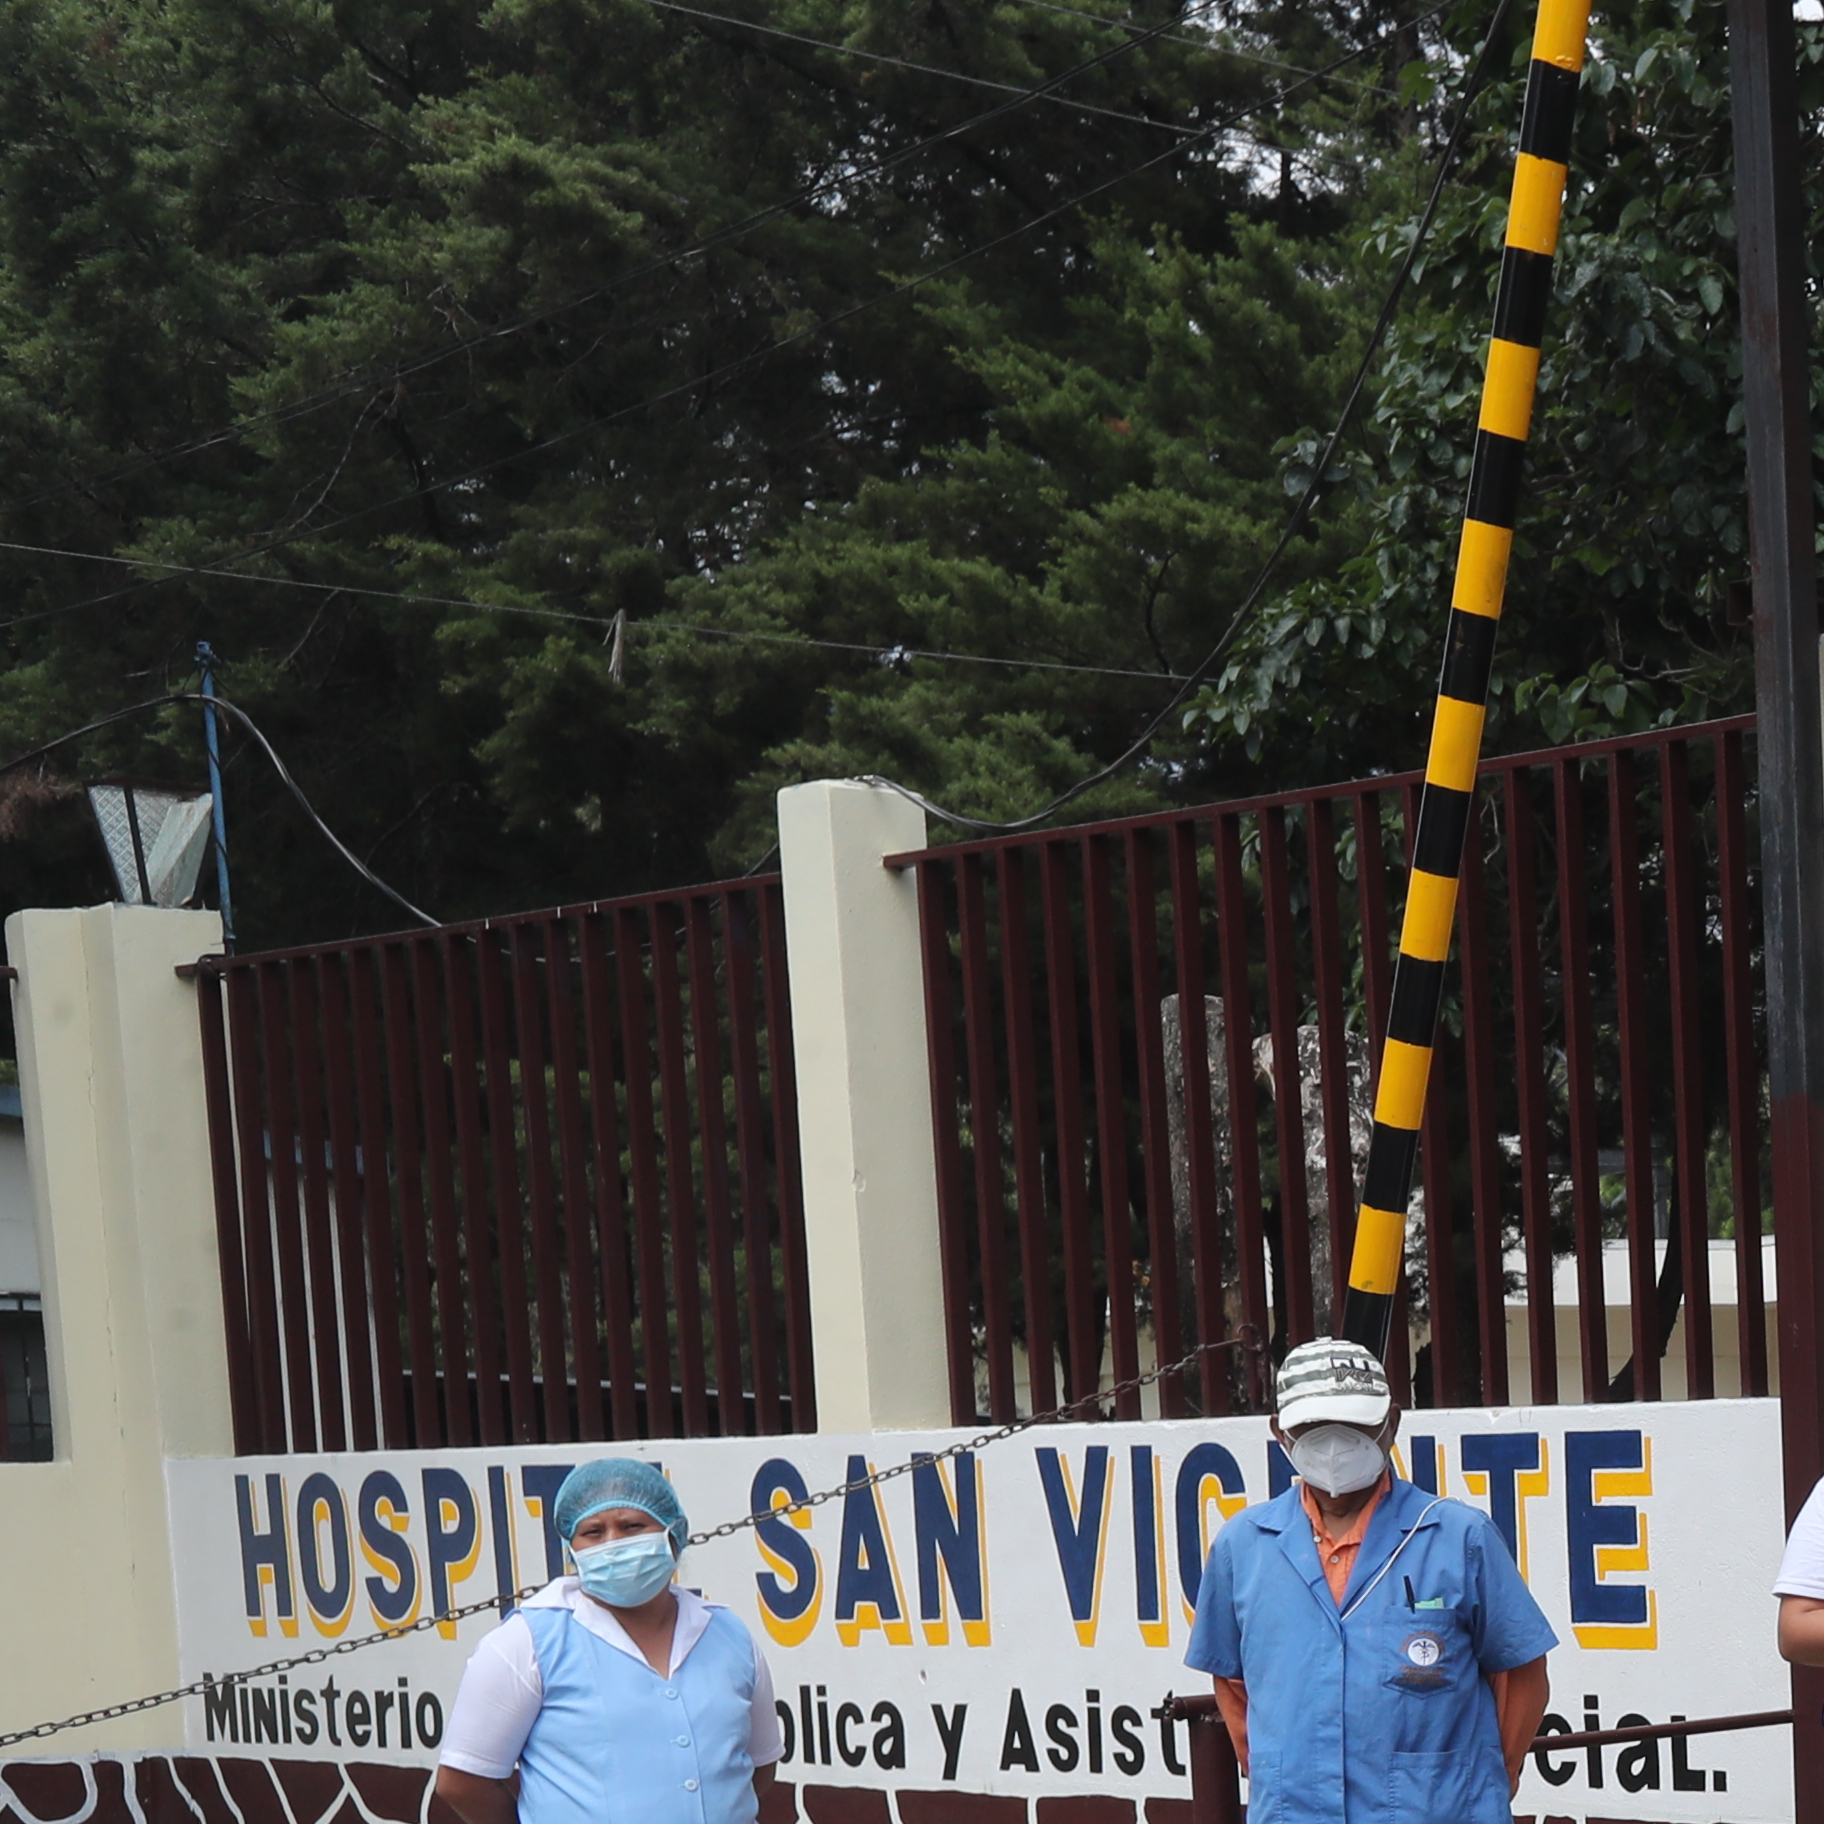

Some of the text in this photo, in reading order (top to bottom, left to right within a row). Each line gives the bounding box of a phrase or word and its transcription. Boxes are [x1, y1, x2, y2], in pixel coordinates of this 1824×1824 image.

[234, 1430, 1658, 1650] HOSPIT SAN VICTE
[931, 1703, 968, 1781] y
[999, 1687, 1187, 1777] Asist
